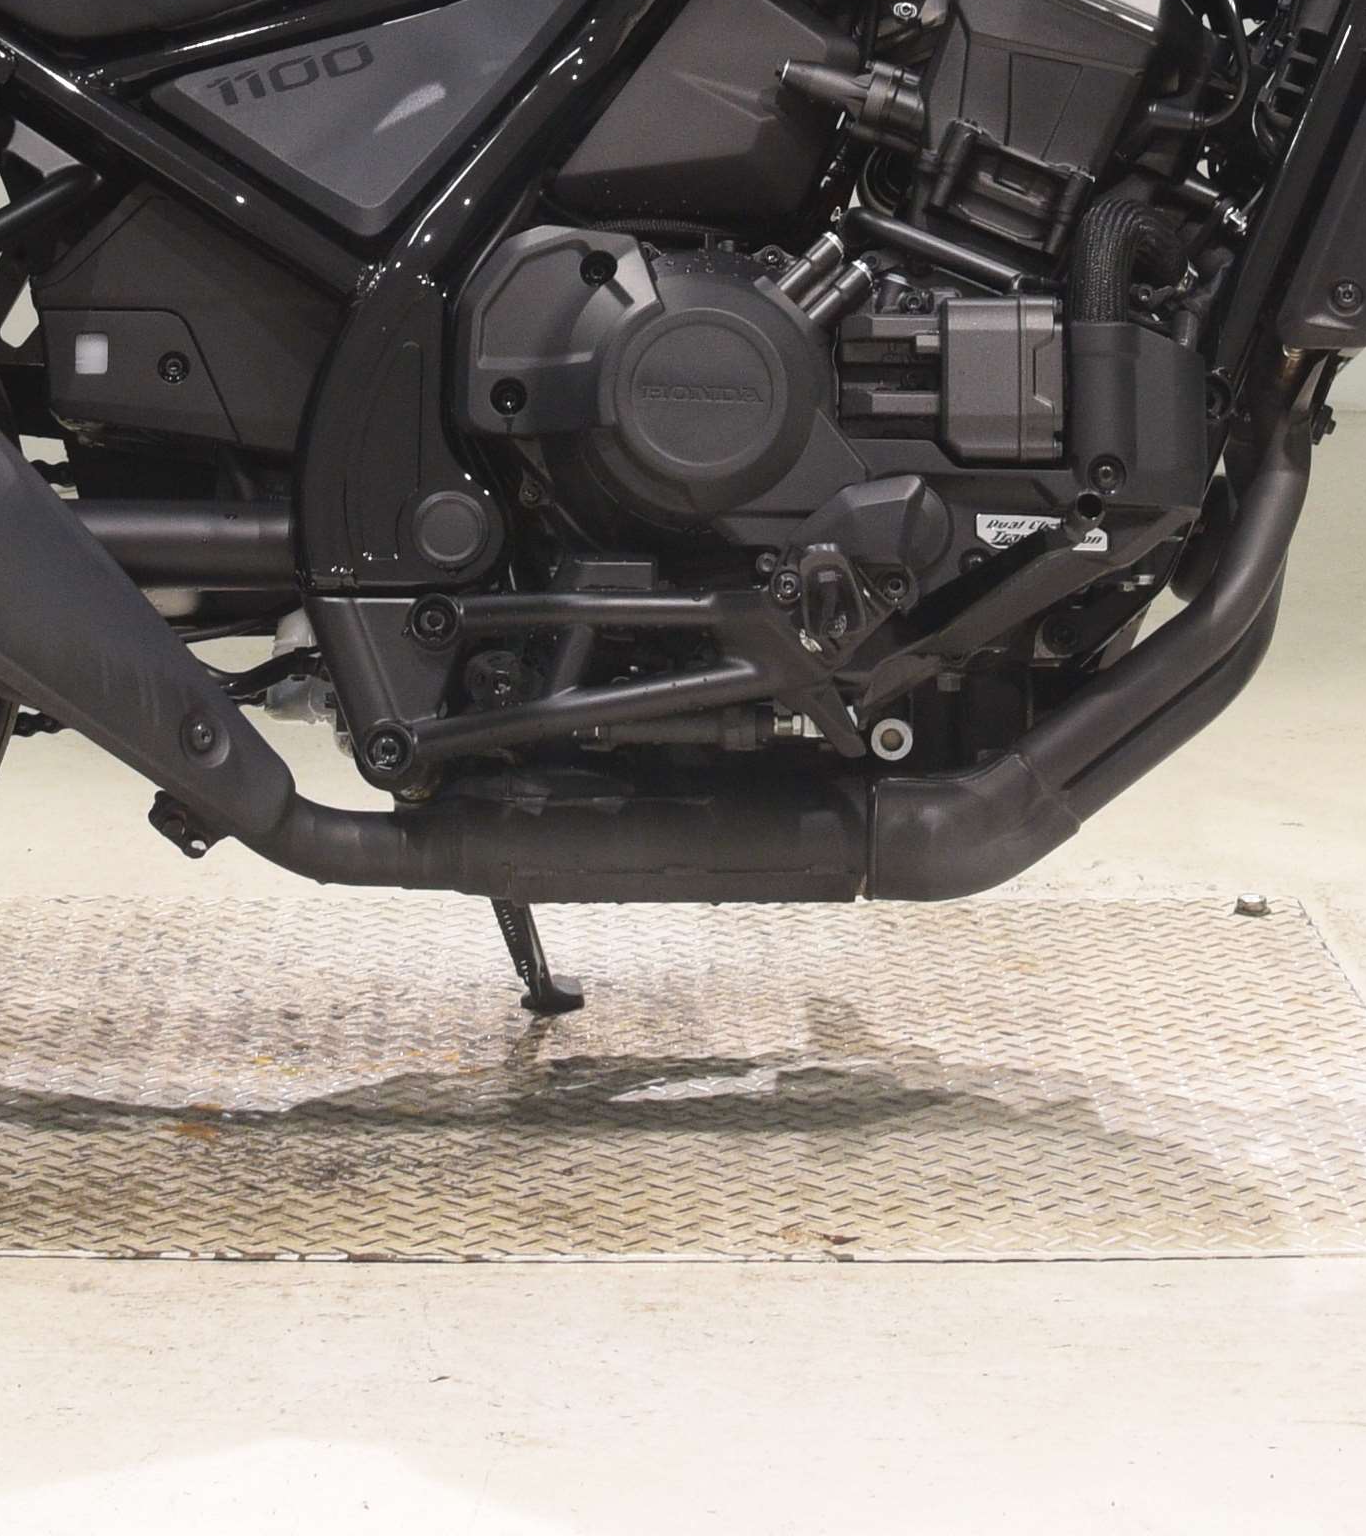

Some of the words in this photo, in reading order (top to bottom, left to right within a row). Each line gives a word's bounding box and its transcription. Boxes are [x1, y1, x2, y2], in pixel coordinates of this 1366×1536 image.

[206, 40, 375, 106] 1100
[642, 384, 764, 404] HONDA
[986, 520, 1025, 529] Dual
